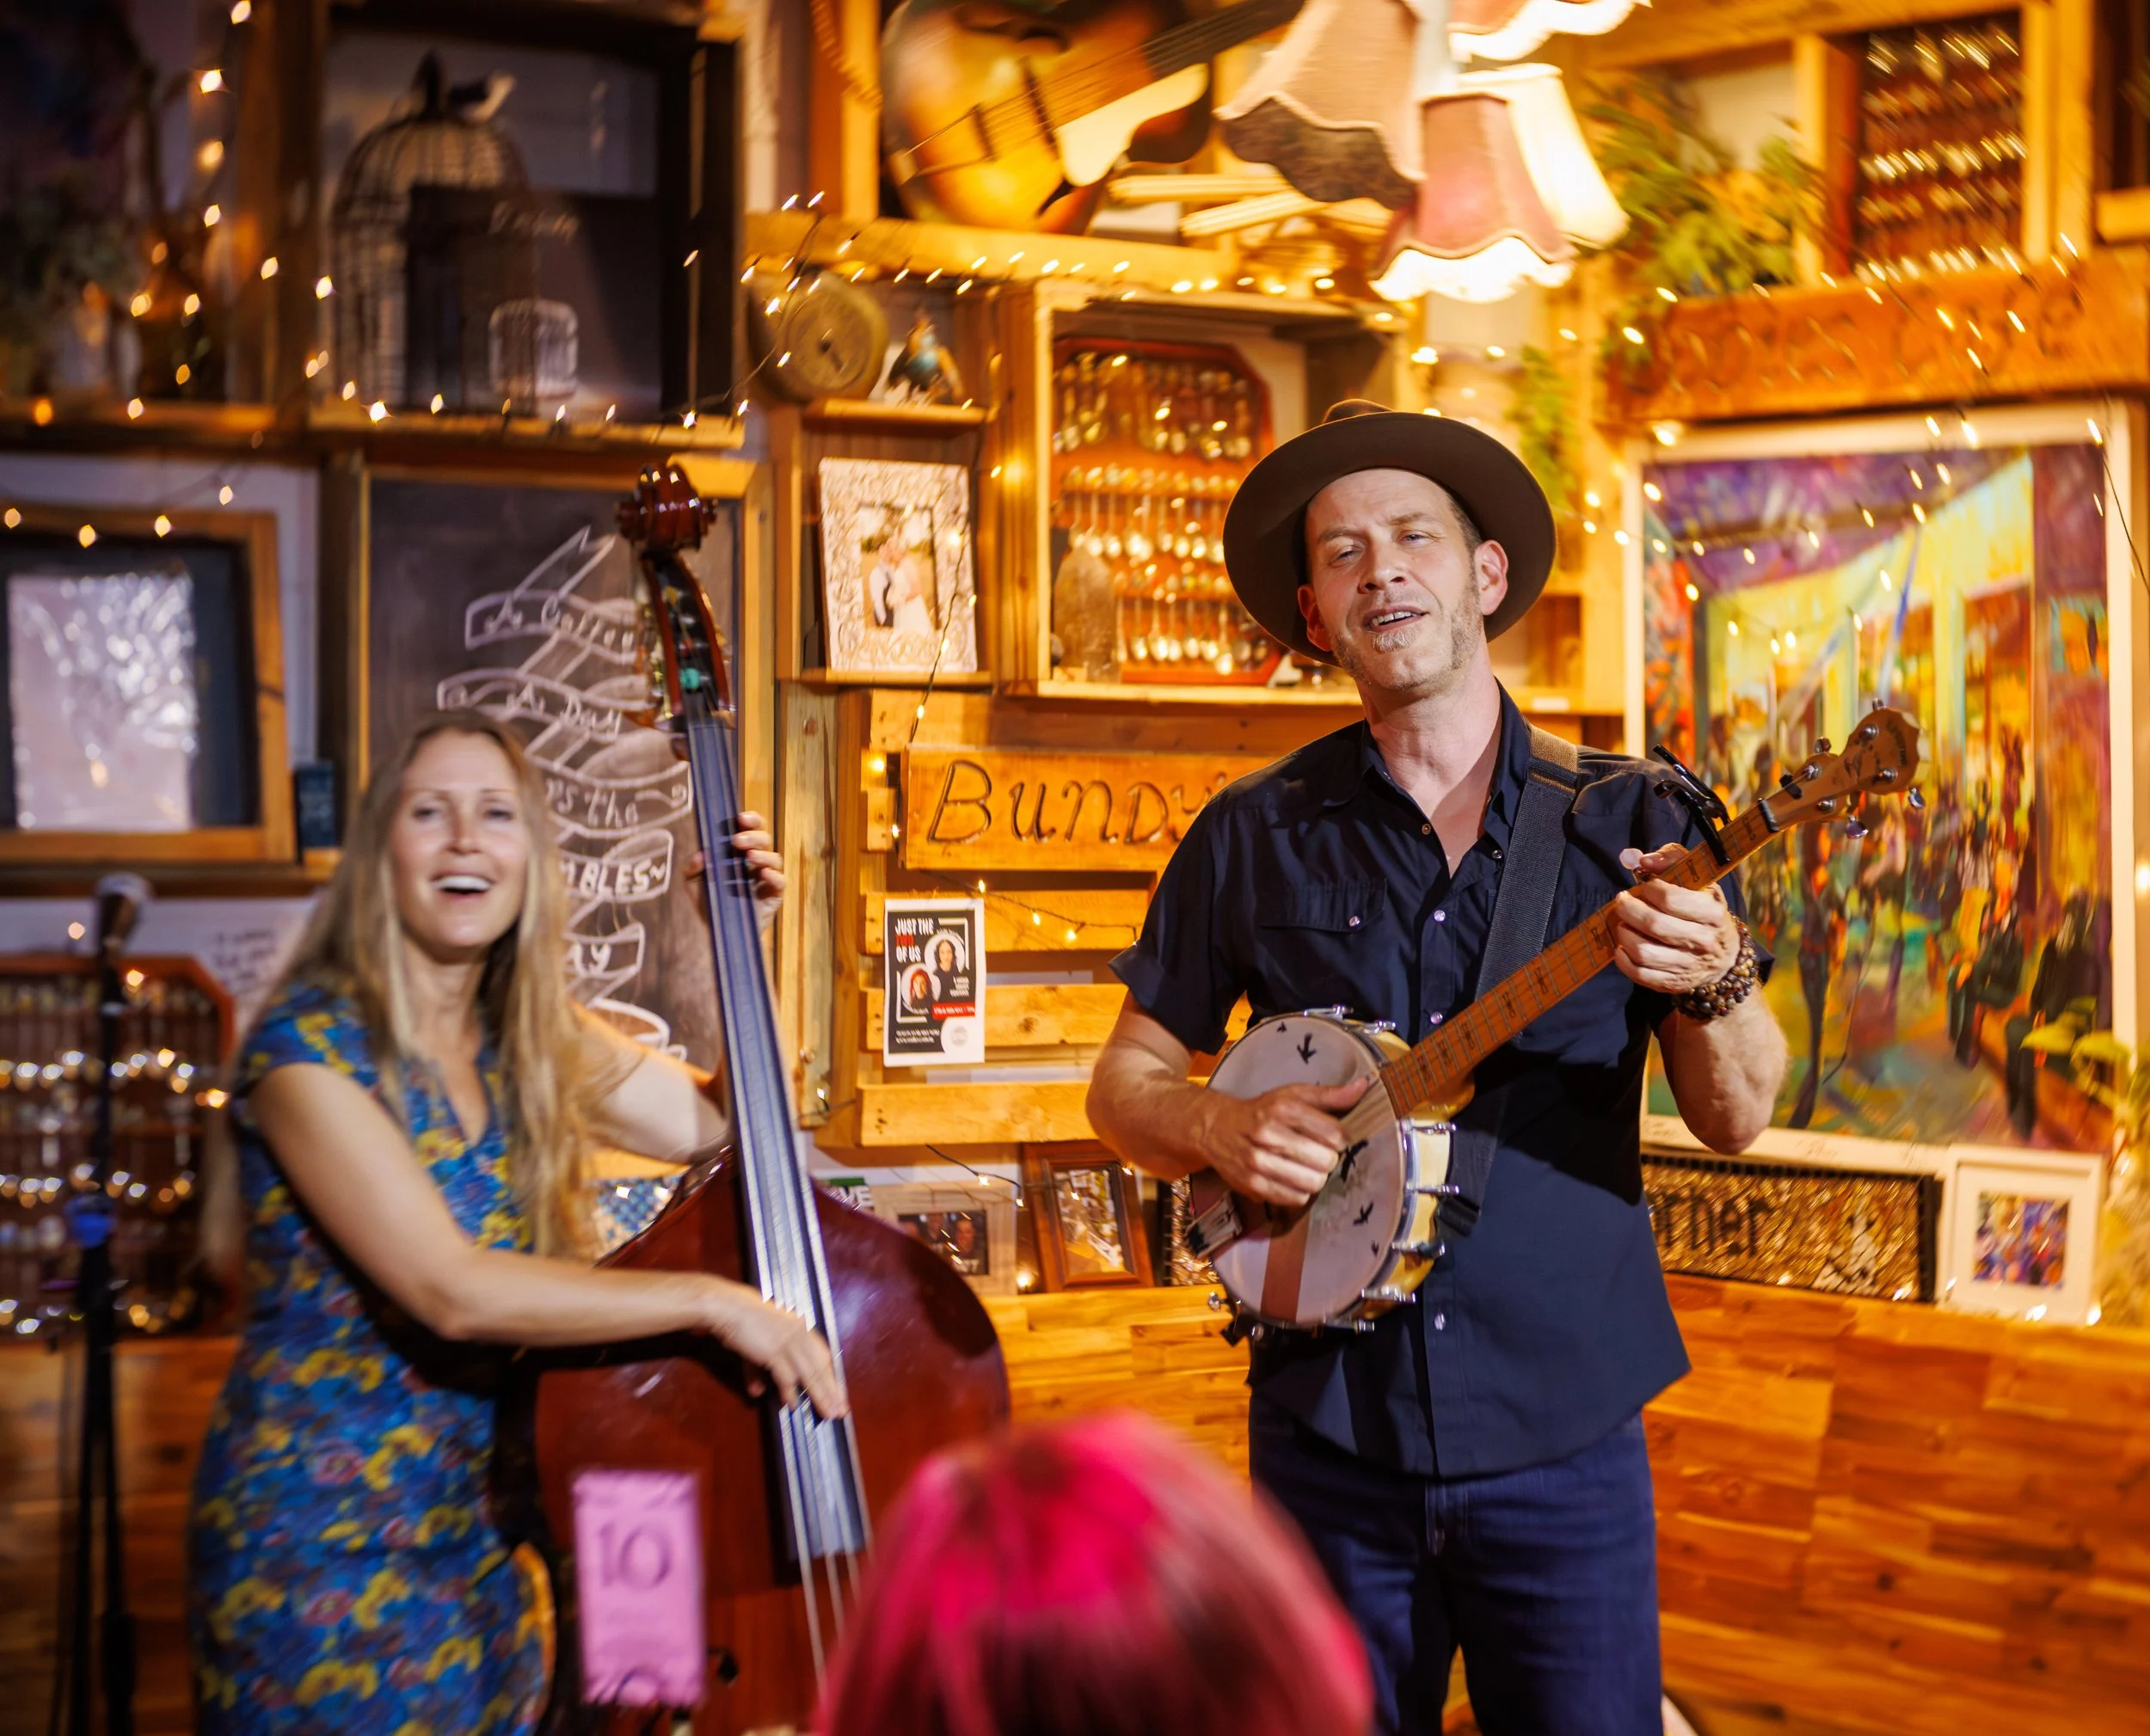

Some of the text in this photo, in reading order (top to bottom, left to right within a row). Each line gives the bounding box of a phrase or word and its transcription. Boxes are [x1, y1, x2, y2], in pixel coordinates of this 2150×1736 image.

[894, 918, 917, 935] JUST
[917, 918, 935, 935] THE
[896, 945, 922, 963] OF US
[838, 1185, 875, 1207] VE
